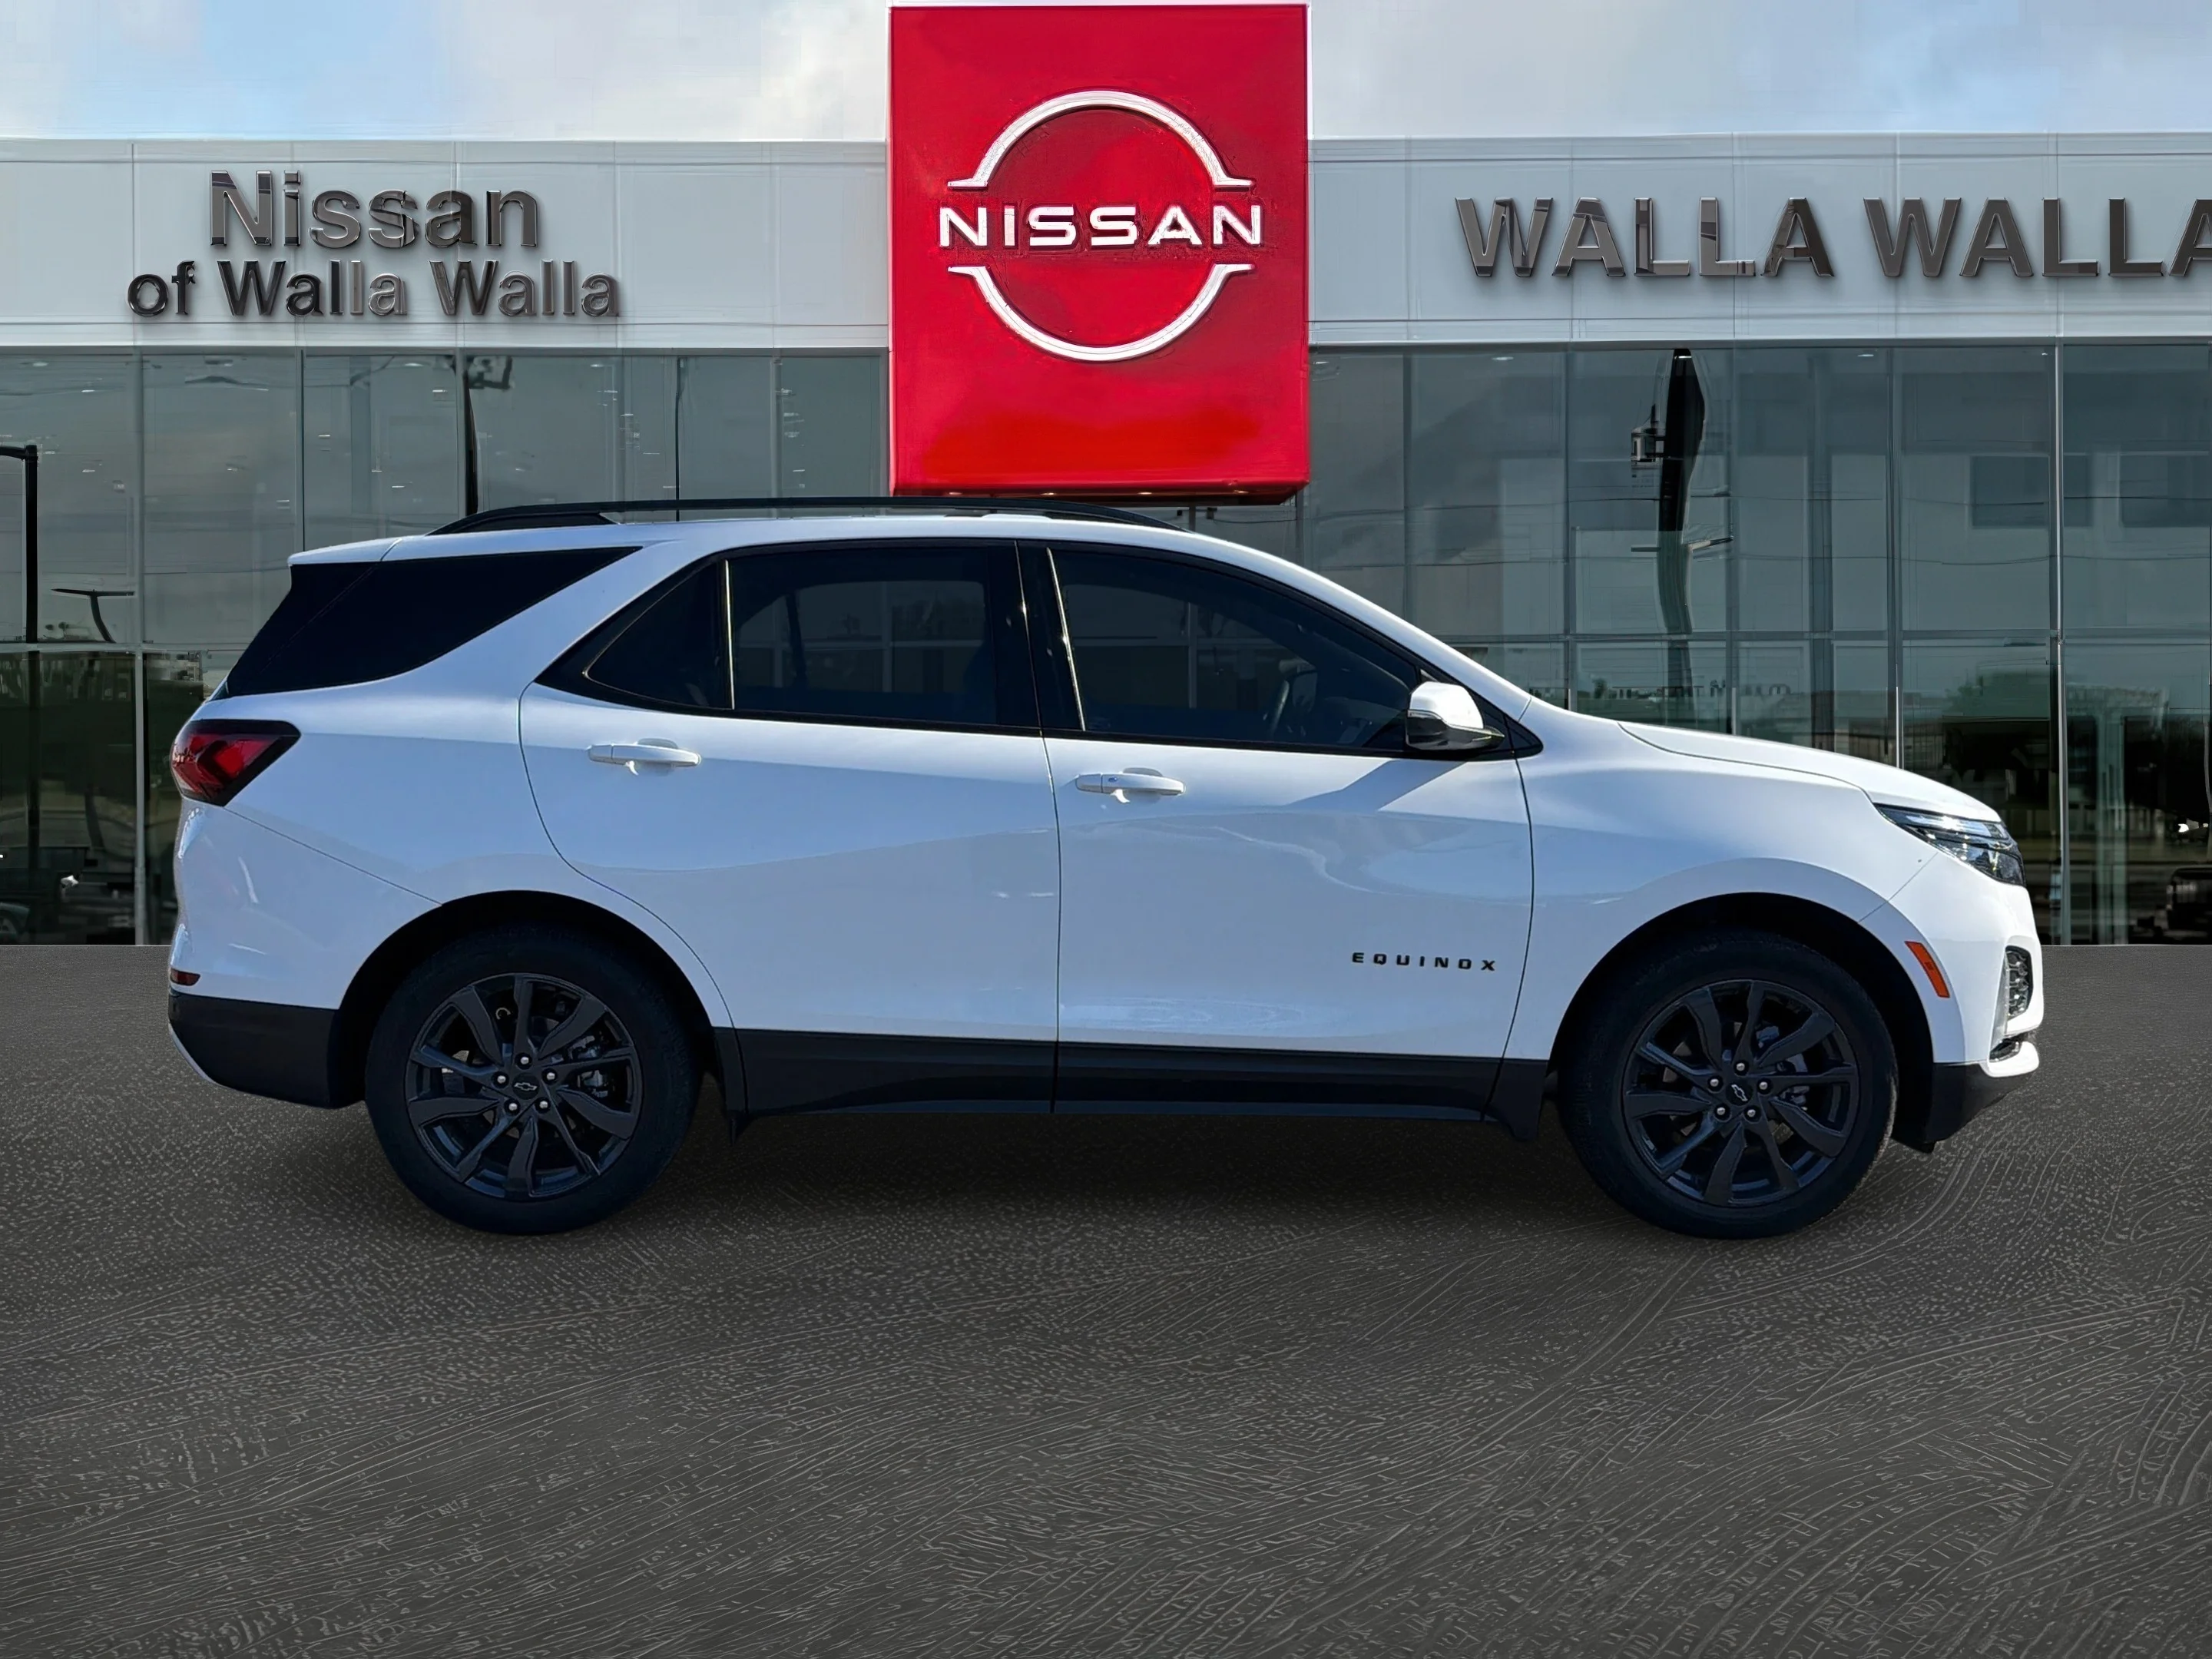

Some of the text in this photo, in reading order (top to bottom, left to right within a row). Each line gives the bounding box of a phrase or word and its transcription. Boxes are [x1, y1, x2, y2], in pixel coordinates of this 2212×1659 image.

[209, 169, 541, 249] Nissan
[939, 205, 1262, 247] NISSAN
[1455, 197, 1835, 278] WALLA
[127, 260, 619, 317] of Walla Walla
[1352, 952, 1495, 971] EQUINOX
